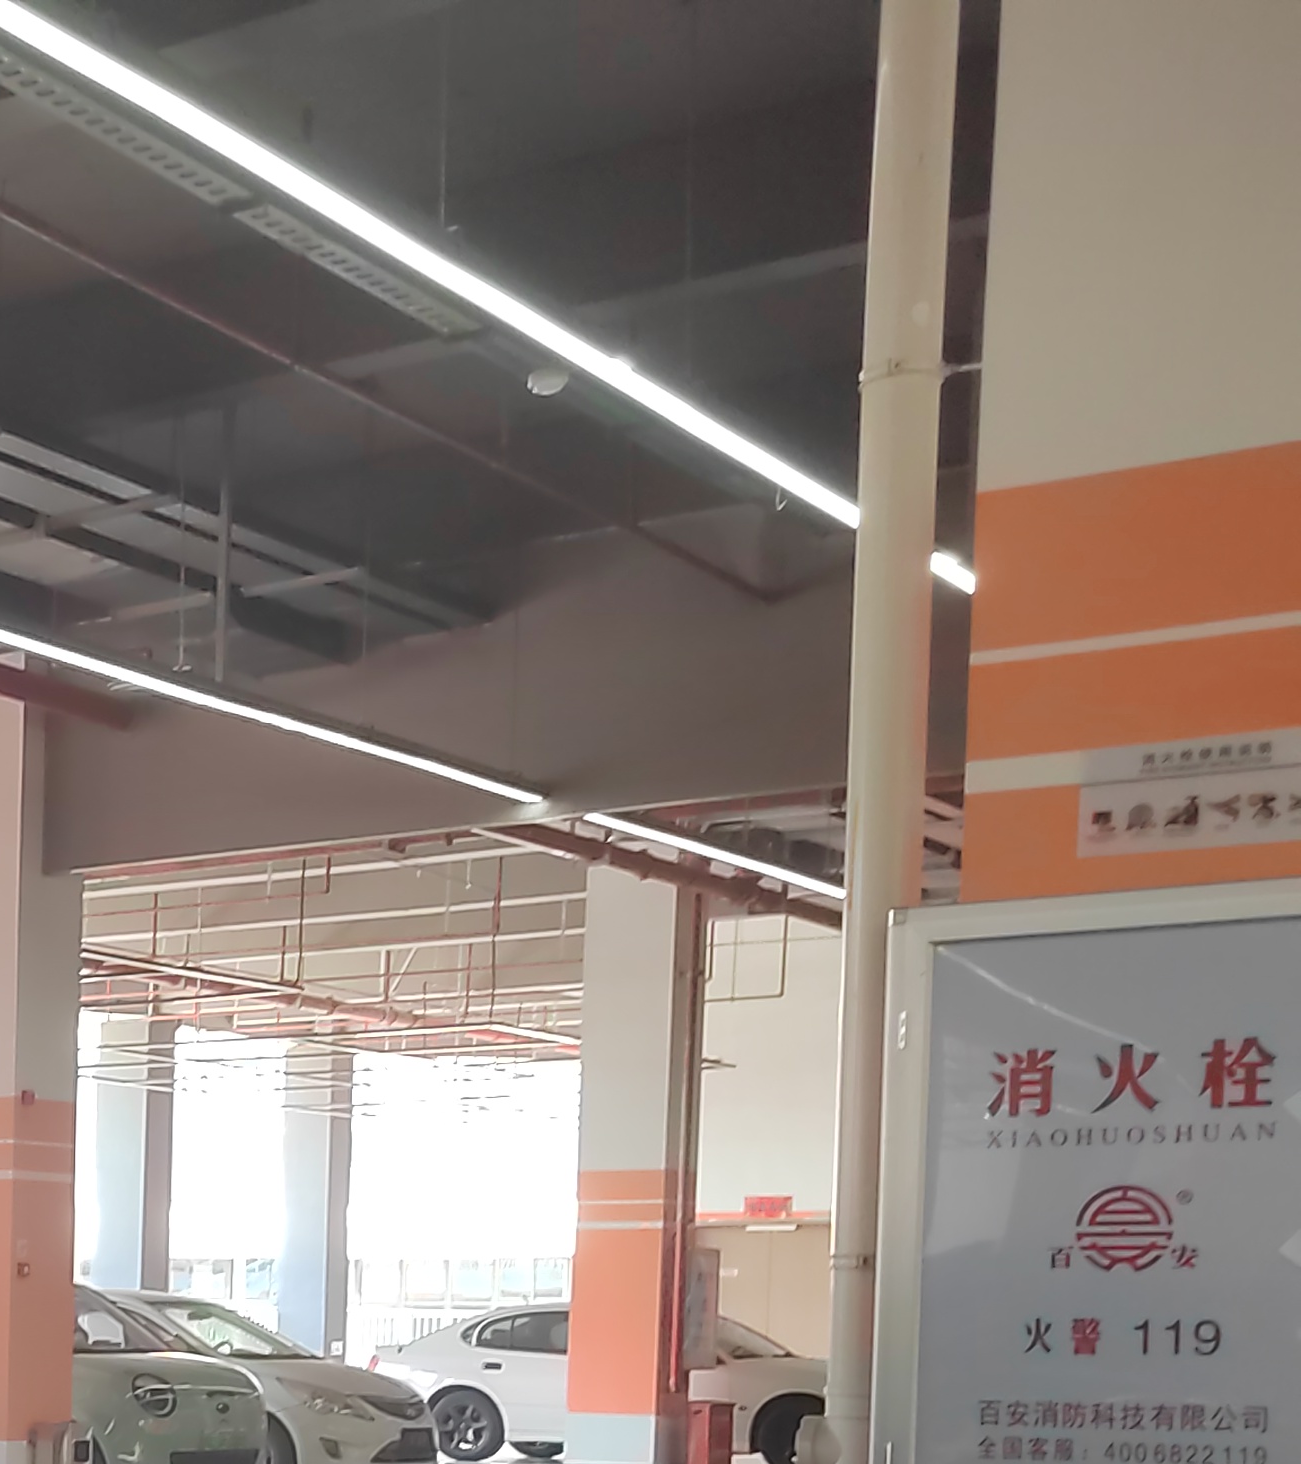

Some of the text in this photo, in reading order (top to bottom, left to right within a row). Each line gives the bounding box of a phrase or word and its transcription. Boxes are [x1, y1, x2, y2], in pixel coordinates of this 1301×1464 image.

[986, 1036, 1278, 1118] 消火栓
[986, 1120, 1278, 1149] XIAOHUOSHUAN
[1023, 1317, 1223, 1357] 火警 119
[977, 1399, 1270, 1435] 百安消防科技有限公司
